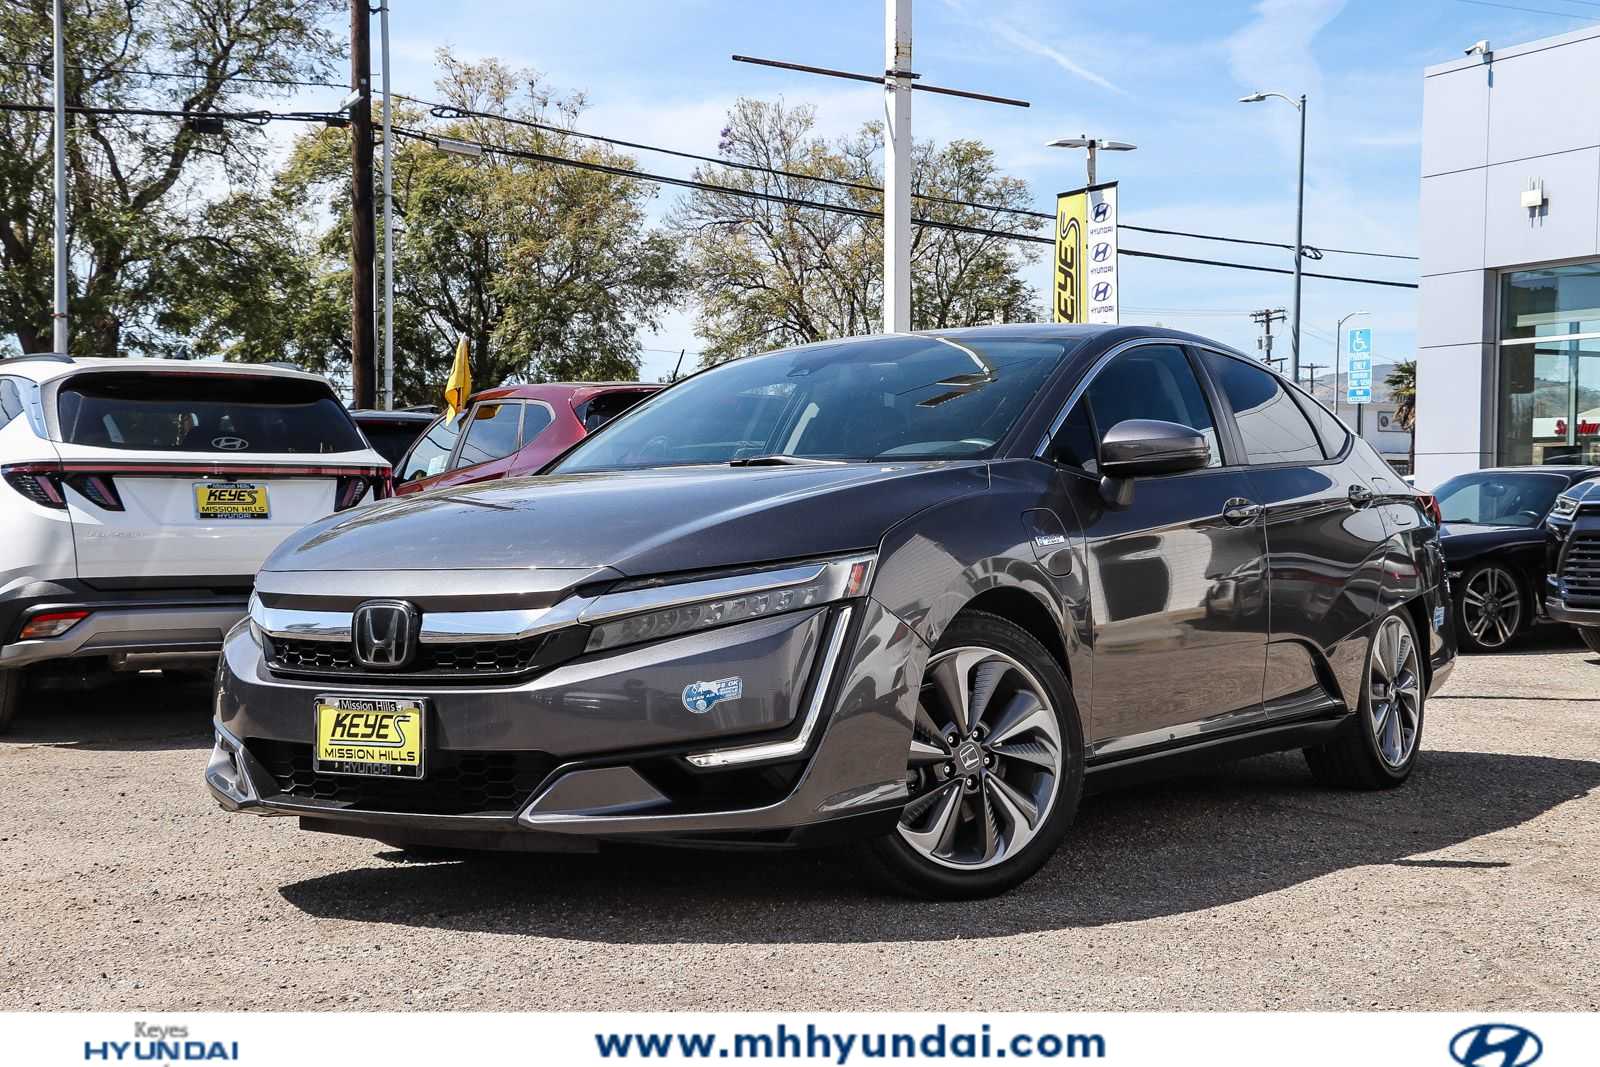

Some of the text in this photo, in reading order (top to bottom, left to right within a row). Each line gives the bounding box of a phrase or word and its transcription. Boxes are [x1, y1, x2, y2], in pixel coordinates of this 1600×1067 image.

[1090, 226, 1114, 235] HYUNDAI
[1058, 211, 1081, 323] EYES
[1090, 266, 1114, 275] HYUNDAI
[1091, 305, 1114, 314] HYUNDAI
[208, 489, 258, 505] KEYES
[341, 700, 396, 711] Mission Hills
[329, 713, 412, 748] KEYES
[325, 748, 416, 762] MISSION HILLS
[344, 763, 391, 775] HYUNDAI
